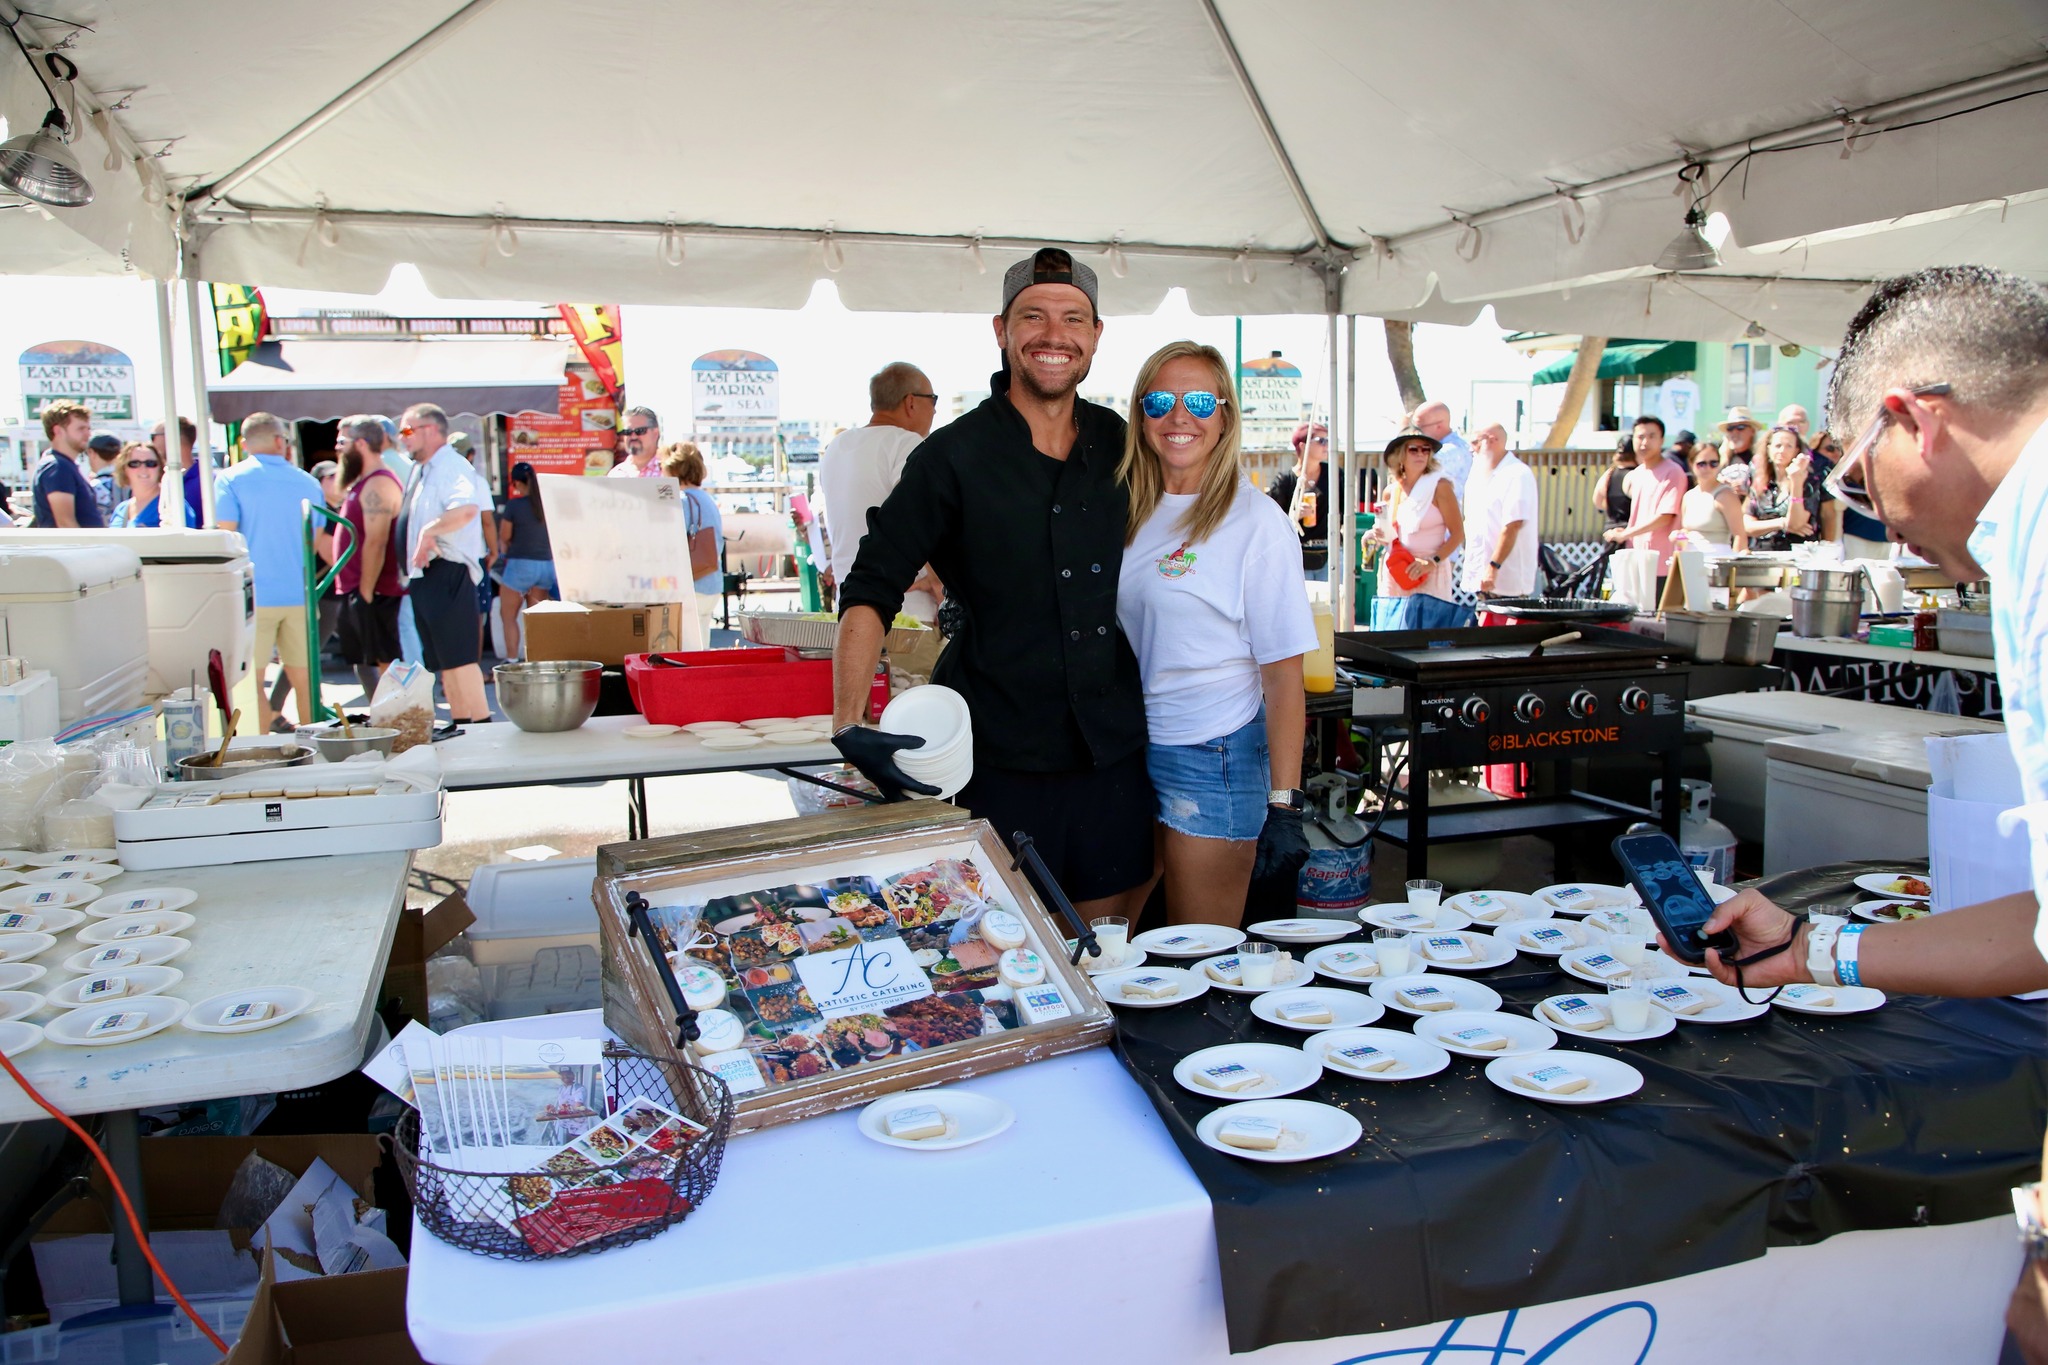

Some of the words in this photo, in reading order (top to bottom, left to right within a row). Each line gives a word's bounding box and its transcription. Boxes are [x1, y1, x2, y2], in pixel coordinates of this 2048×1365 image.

[505, 319, 535, 333] TACOS
[27, 366, 70, 379] EAST
[77, 366, 127, 379] PASS
[696, 372, 730, 383] EAST
[735, 372, 774, 383] PASS
[39, 381, 116, 393] MARINA
[1242, 379, 1262, 388] AST
[706, 384, 765, 395] MARINA
[1244, 390, 1290, 399] MARINA
[1421, 697, 1455, 705] BLACKSTONE
[1503, 727, 1620, 750] BLACKSTONE
[1305, 866, 1351, 881] Rapid
[831, 943, 899, 995] AC
[817, 993, 868, 1009] ARTISTIC
[871, 981, 926, 997] CATERING
[880, 997, 905, 1005] TOMMY
[1034, 1004, 1065, 1012] SEAFOOD
[720, 1059, 750, 1071] DESTIN
[722, 1065, 754, 1076] SEAFOOD
